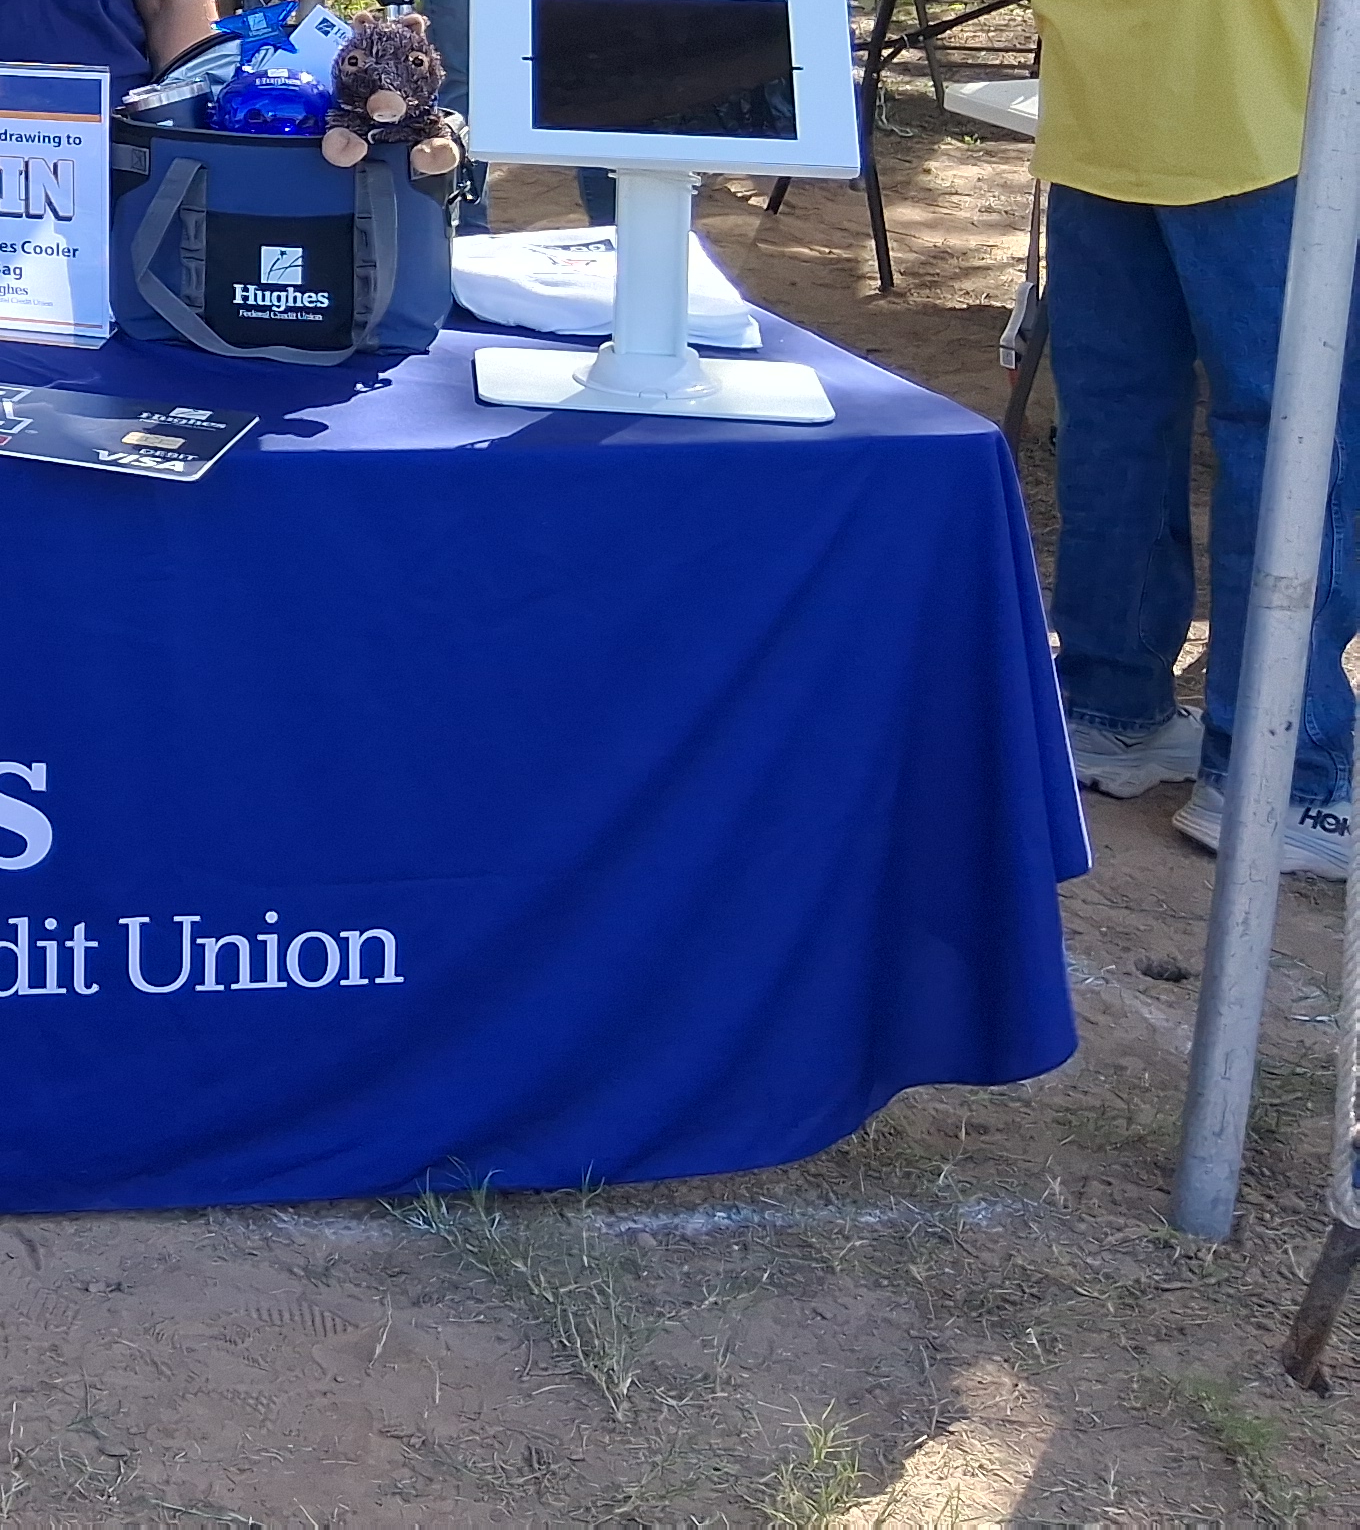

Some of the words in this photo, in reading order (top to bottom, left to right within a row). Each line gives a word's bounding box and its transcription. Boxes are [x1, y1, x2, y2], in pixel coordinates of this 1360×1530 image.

[0, 129, 62, 147] drawing
[67, 134, 82, 146] to
[21, 241, 79, 258] Cooler
[233, 284, 329, 311] Hughes
[239, 309, 270, 319] Federal
[270, 311, 296, 320] Credit
[297, 311, 323, 321] Union
[92, 448, 185, 473] VISA
[1298, 807, 1352, 837] HOK
[118, 908, 405, 992] Union
